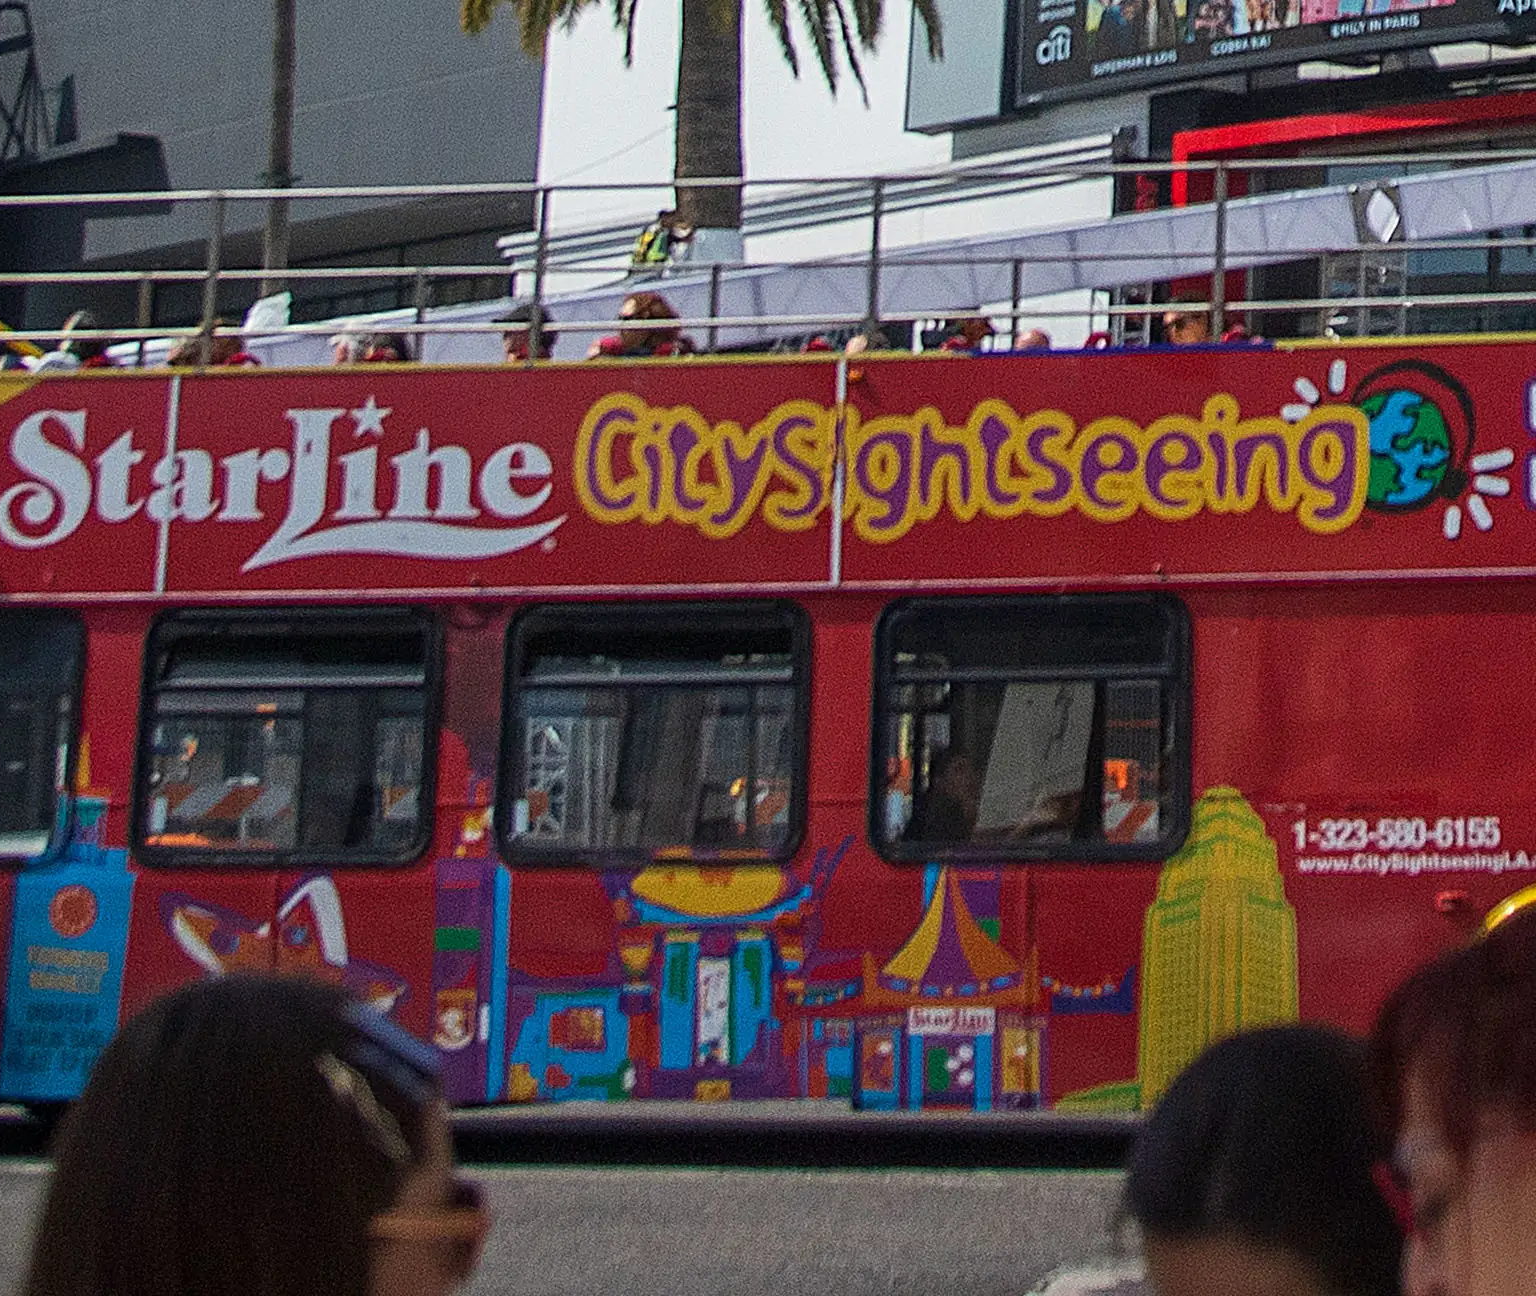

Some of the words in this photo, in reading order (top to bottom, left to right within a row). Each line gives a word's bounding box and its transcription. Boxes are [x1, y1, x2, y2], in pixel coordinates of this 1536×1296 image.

[1329, 19, 1364, 38] EMILY
[1366, 18, 1381, 32] IN
[1382, 14, 1421, 31] PARIS
[1035, 24, 1073, 65] citi
[1210, 38, 1249, 56] COBRA
